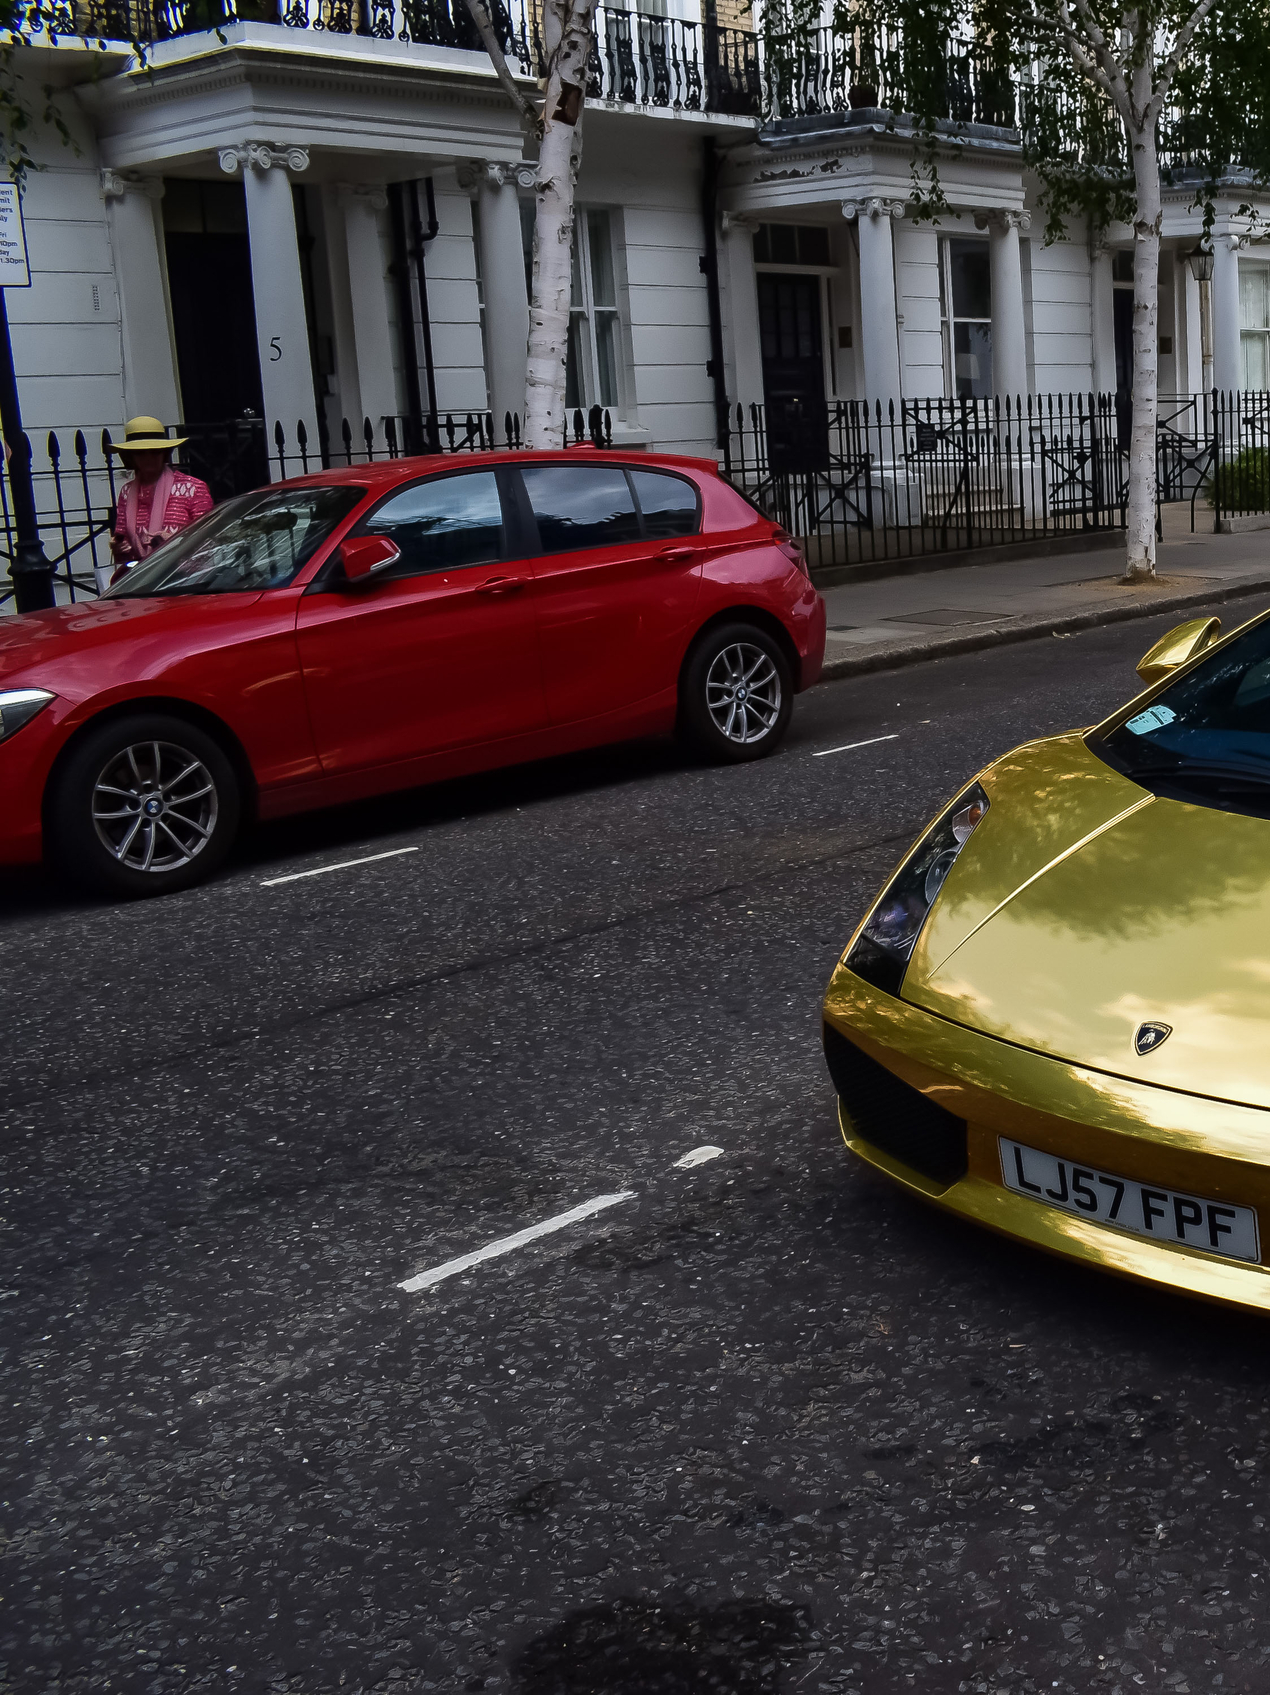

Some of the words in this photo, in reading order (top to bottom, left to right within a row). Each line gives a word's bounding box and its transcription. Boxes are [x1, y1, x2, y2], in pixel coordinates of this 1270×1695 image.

[270, 336, 282, 361] 5
[1014, 1146, 1124, 1220] LJ57
[1141, 1188, 1236, 1247] FPF
